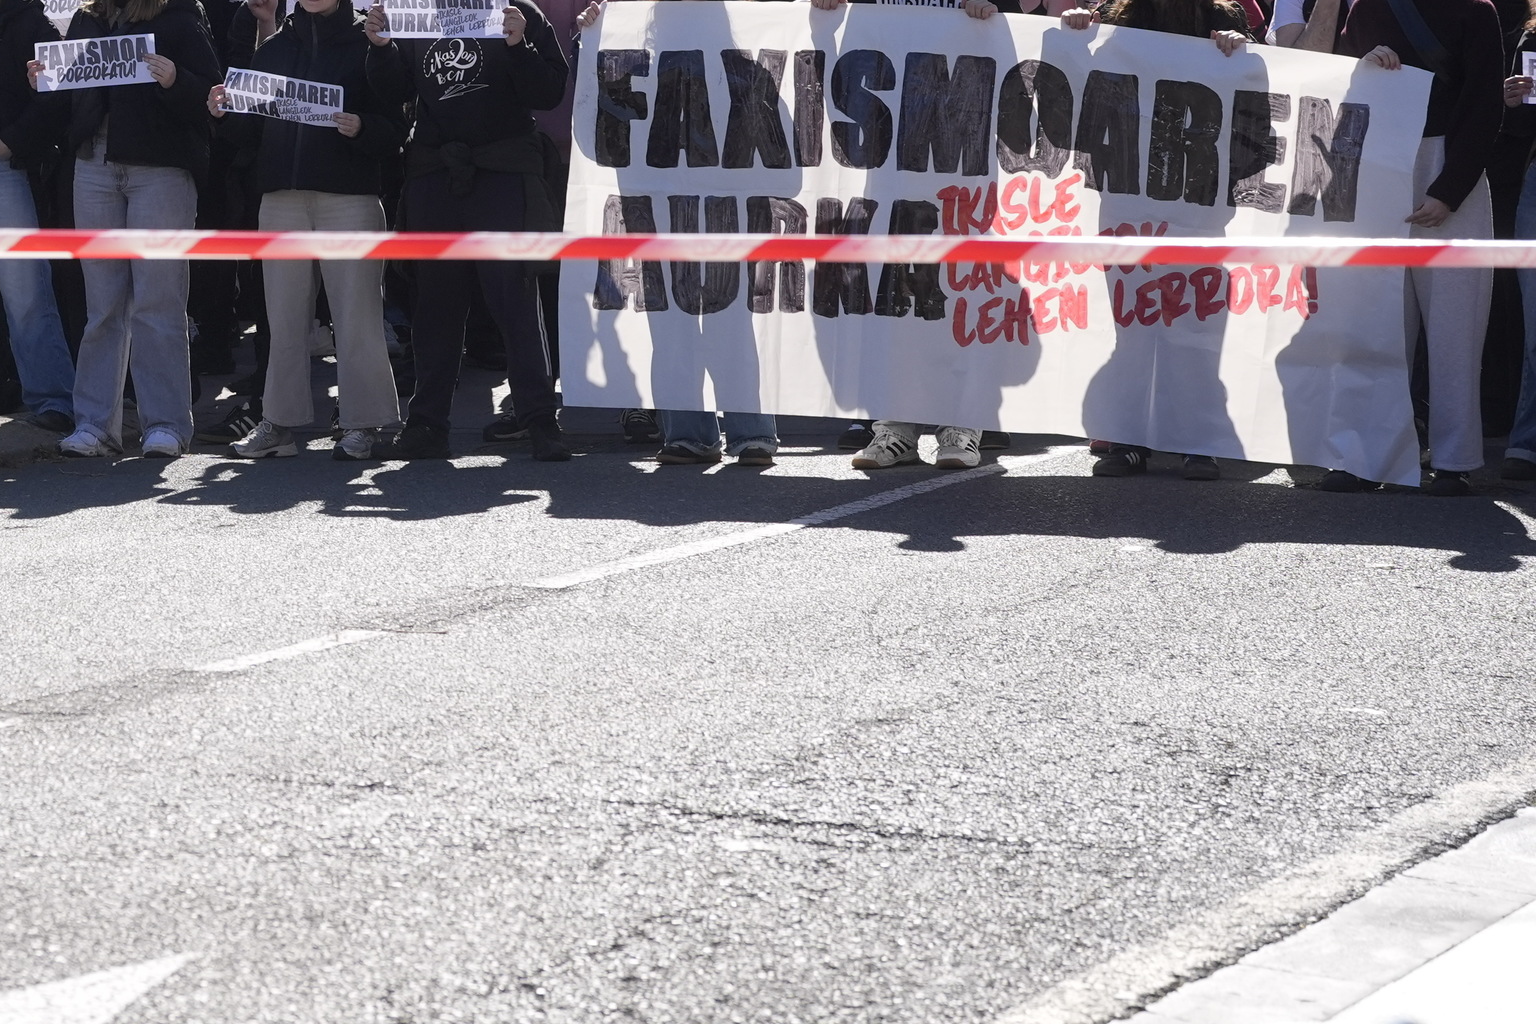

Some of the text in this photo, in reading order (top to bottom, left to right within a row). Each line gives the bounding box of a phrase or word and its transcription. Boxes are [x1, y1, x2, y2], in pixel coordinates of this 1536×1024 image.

[38, 37, 149, 71] FAXISMOA
[56, 60, 137, 83] BORROKATU!
[225, 71, 341, 108] FAXISMOAREN
[594, 49, 1370, 223] FAXISMOAREN
[592, 173, 1082, 321] AURKA IKASLE
[953, 262, 1319, 348] LEHEN LERRORA!
